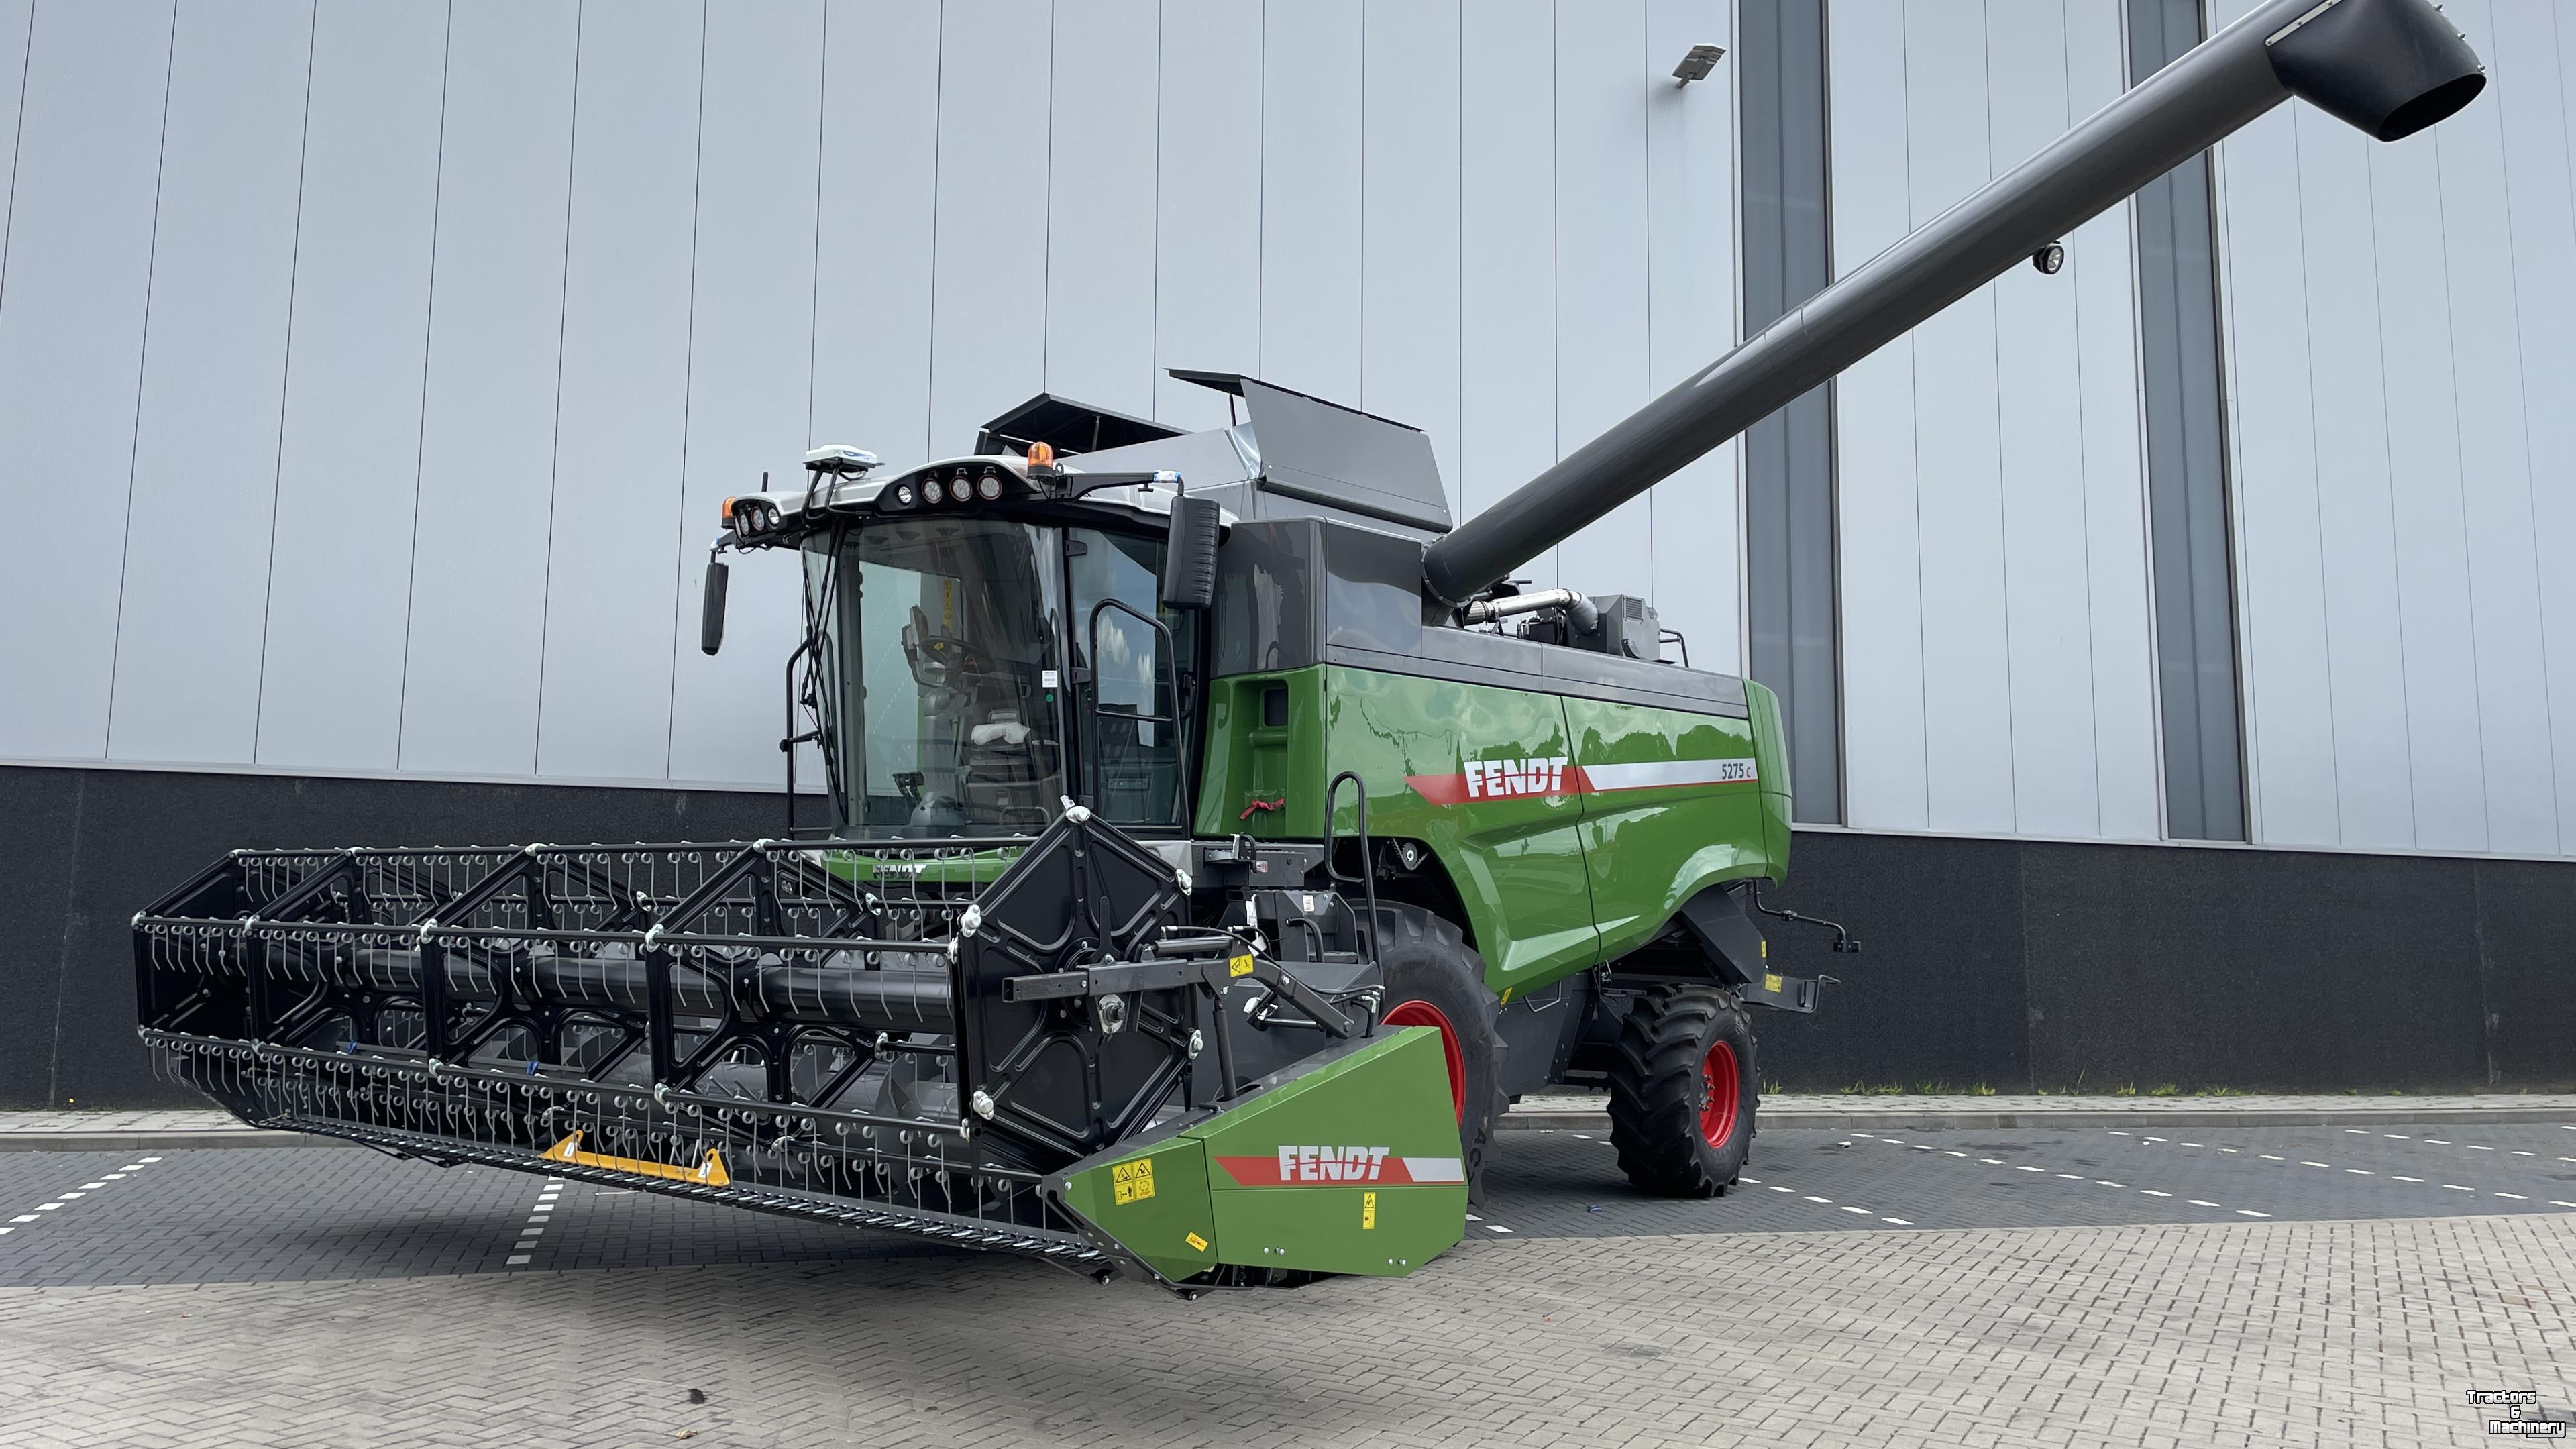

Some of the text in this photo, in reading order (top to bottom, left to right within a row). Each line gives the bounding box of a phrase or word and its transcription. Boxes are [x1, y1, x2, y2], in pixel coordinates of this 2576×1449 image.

[1464, 756, 1568, 798] FENDT
[1722, 763, 1744, 780] 5275
[1278, 1146, 1390, 1181] FENDT
